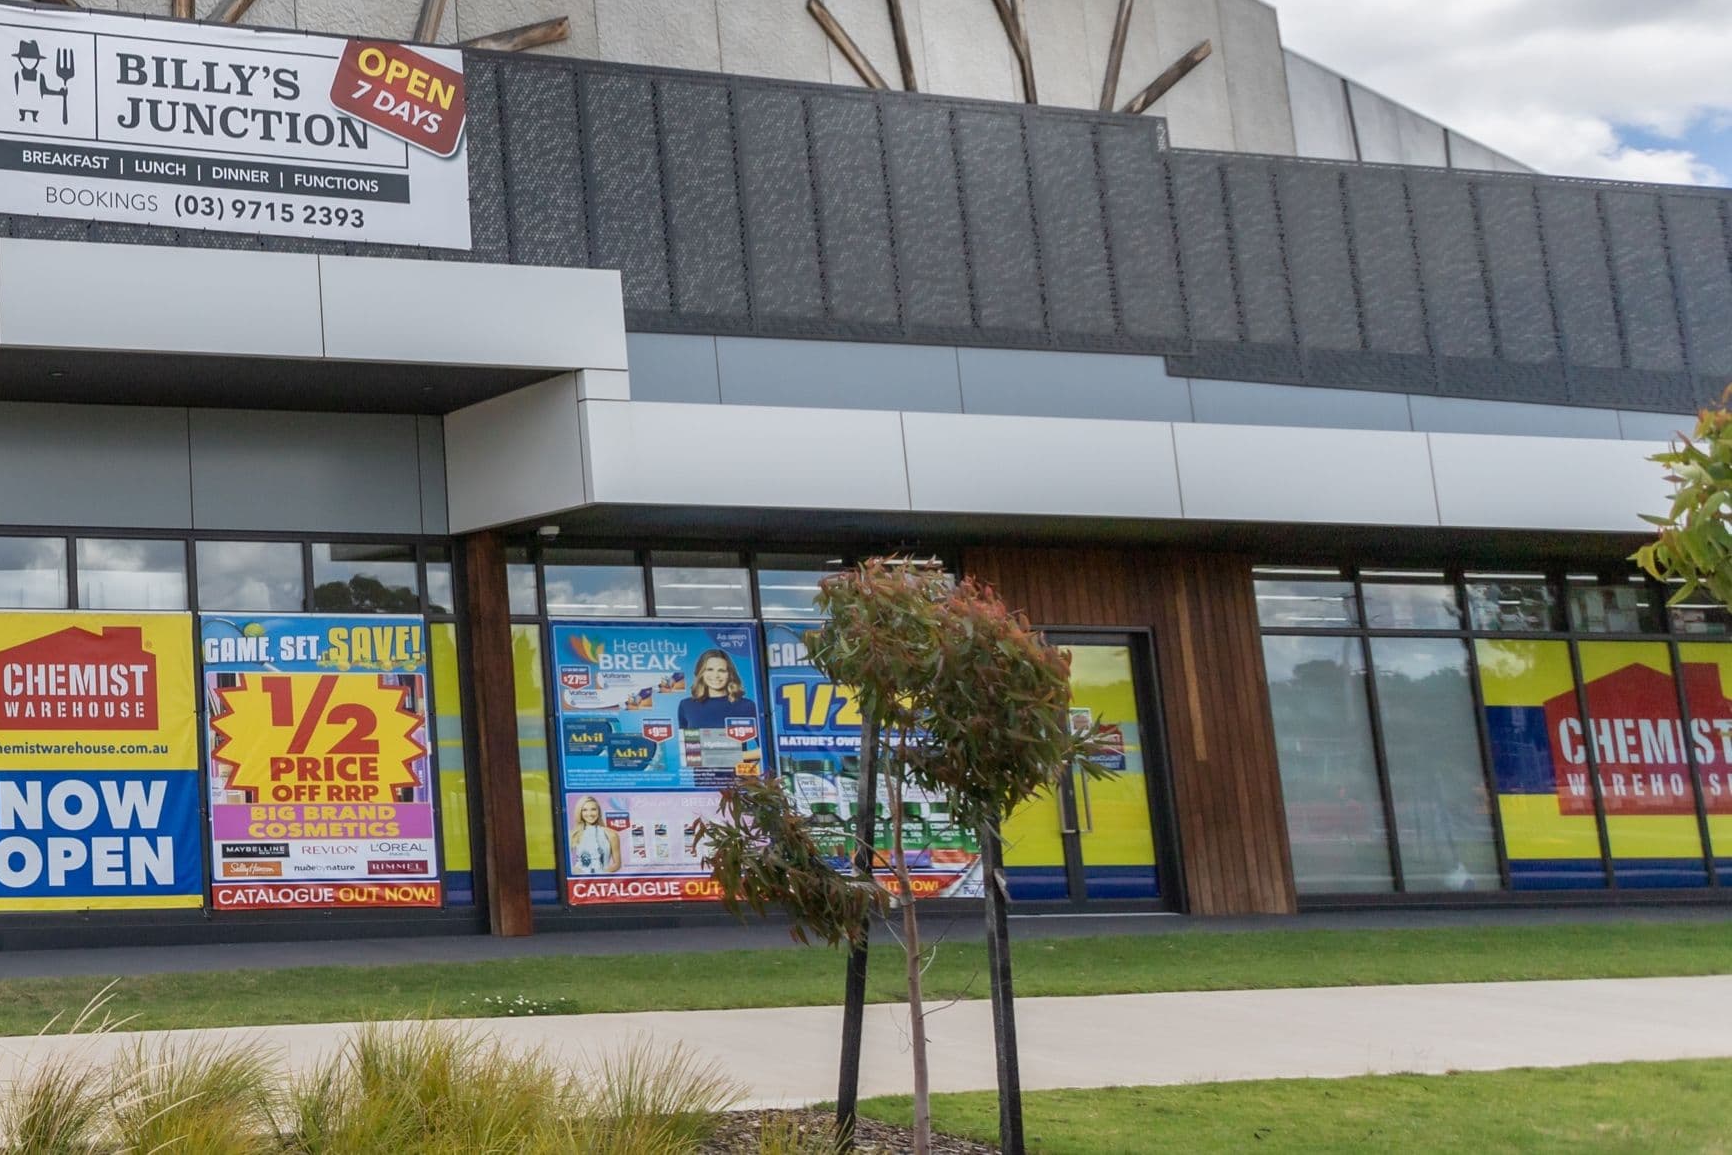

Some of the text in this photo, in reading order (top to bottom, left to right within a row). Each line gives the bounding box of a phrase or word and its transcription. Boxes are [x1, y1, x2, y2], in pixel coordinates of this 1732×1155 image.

[115, 52, 301, 101] BILLY'S
[357, 47, 457, 111] OPEN
[351, 80, 442, 134] 7 DAYS
[117, 97, 369, 150] JUNCTION
[22, 149, 379, 193] BREAKFAST LUNCH DINNER FUNCTIONS
[45, 185, 365, 229] BOOKINGS (03) 9715 2393
[328, 626, 422, 663] SAVE!
[613, 638, 688, 657] Healthy
[599, 653, 682, 671] BREAK
[3, 662, 149, 697] CHEMIST
[3, 700, 146, 719] WAREHOUSE
[570, 732, 604, 744] Advil
[779, 735, 835, 747] NATURE'S
[1558, 717, 1732, 764] CHEMIST
[614, 747, 648, 758] Advil
[270, 757, 380, 782] PRICE
[272, 784, 379, 802] OFF RRP
[1566, 773, 1732, 797] WREHOS
[250, 806, 397, 822] BIG BRAND
[248, 822, 400, 838] COSMETICS
[226, 845, 285, 854] MAYBELLINE
[301, 845, 358, 855] REVLON
[372, 862, 421, 870] RIMMEL
[573, 881, 720, 898] CATALOGUE OUT
[908, 880, 940, 892] OW!
[218, 887, 436, 905] CATALOGUE OUT NOW!
